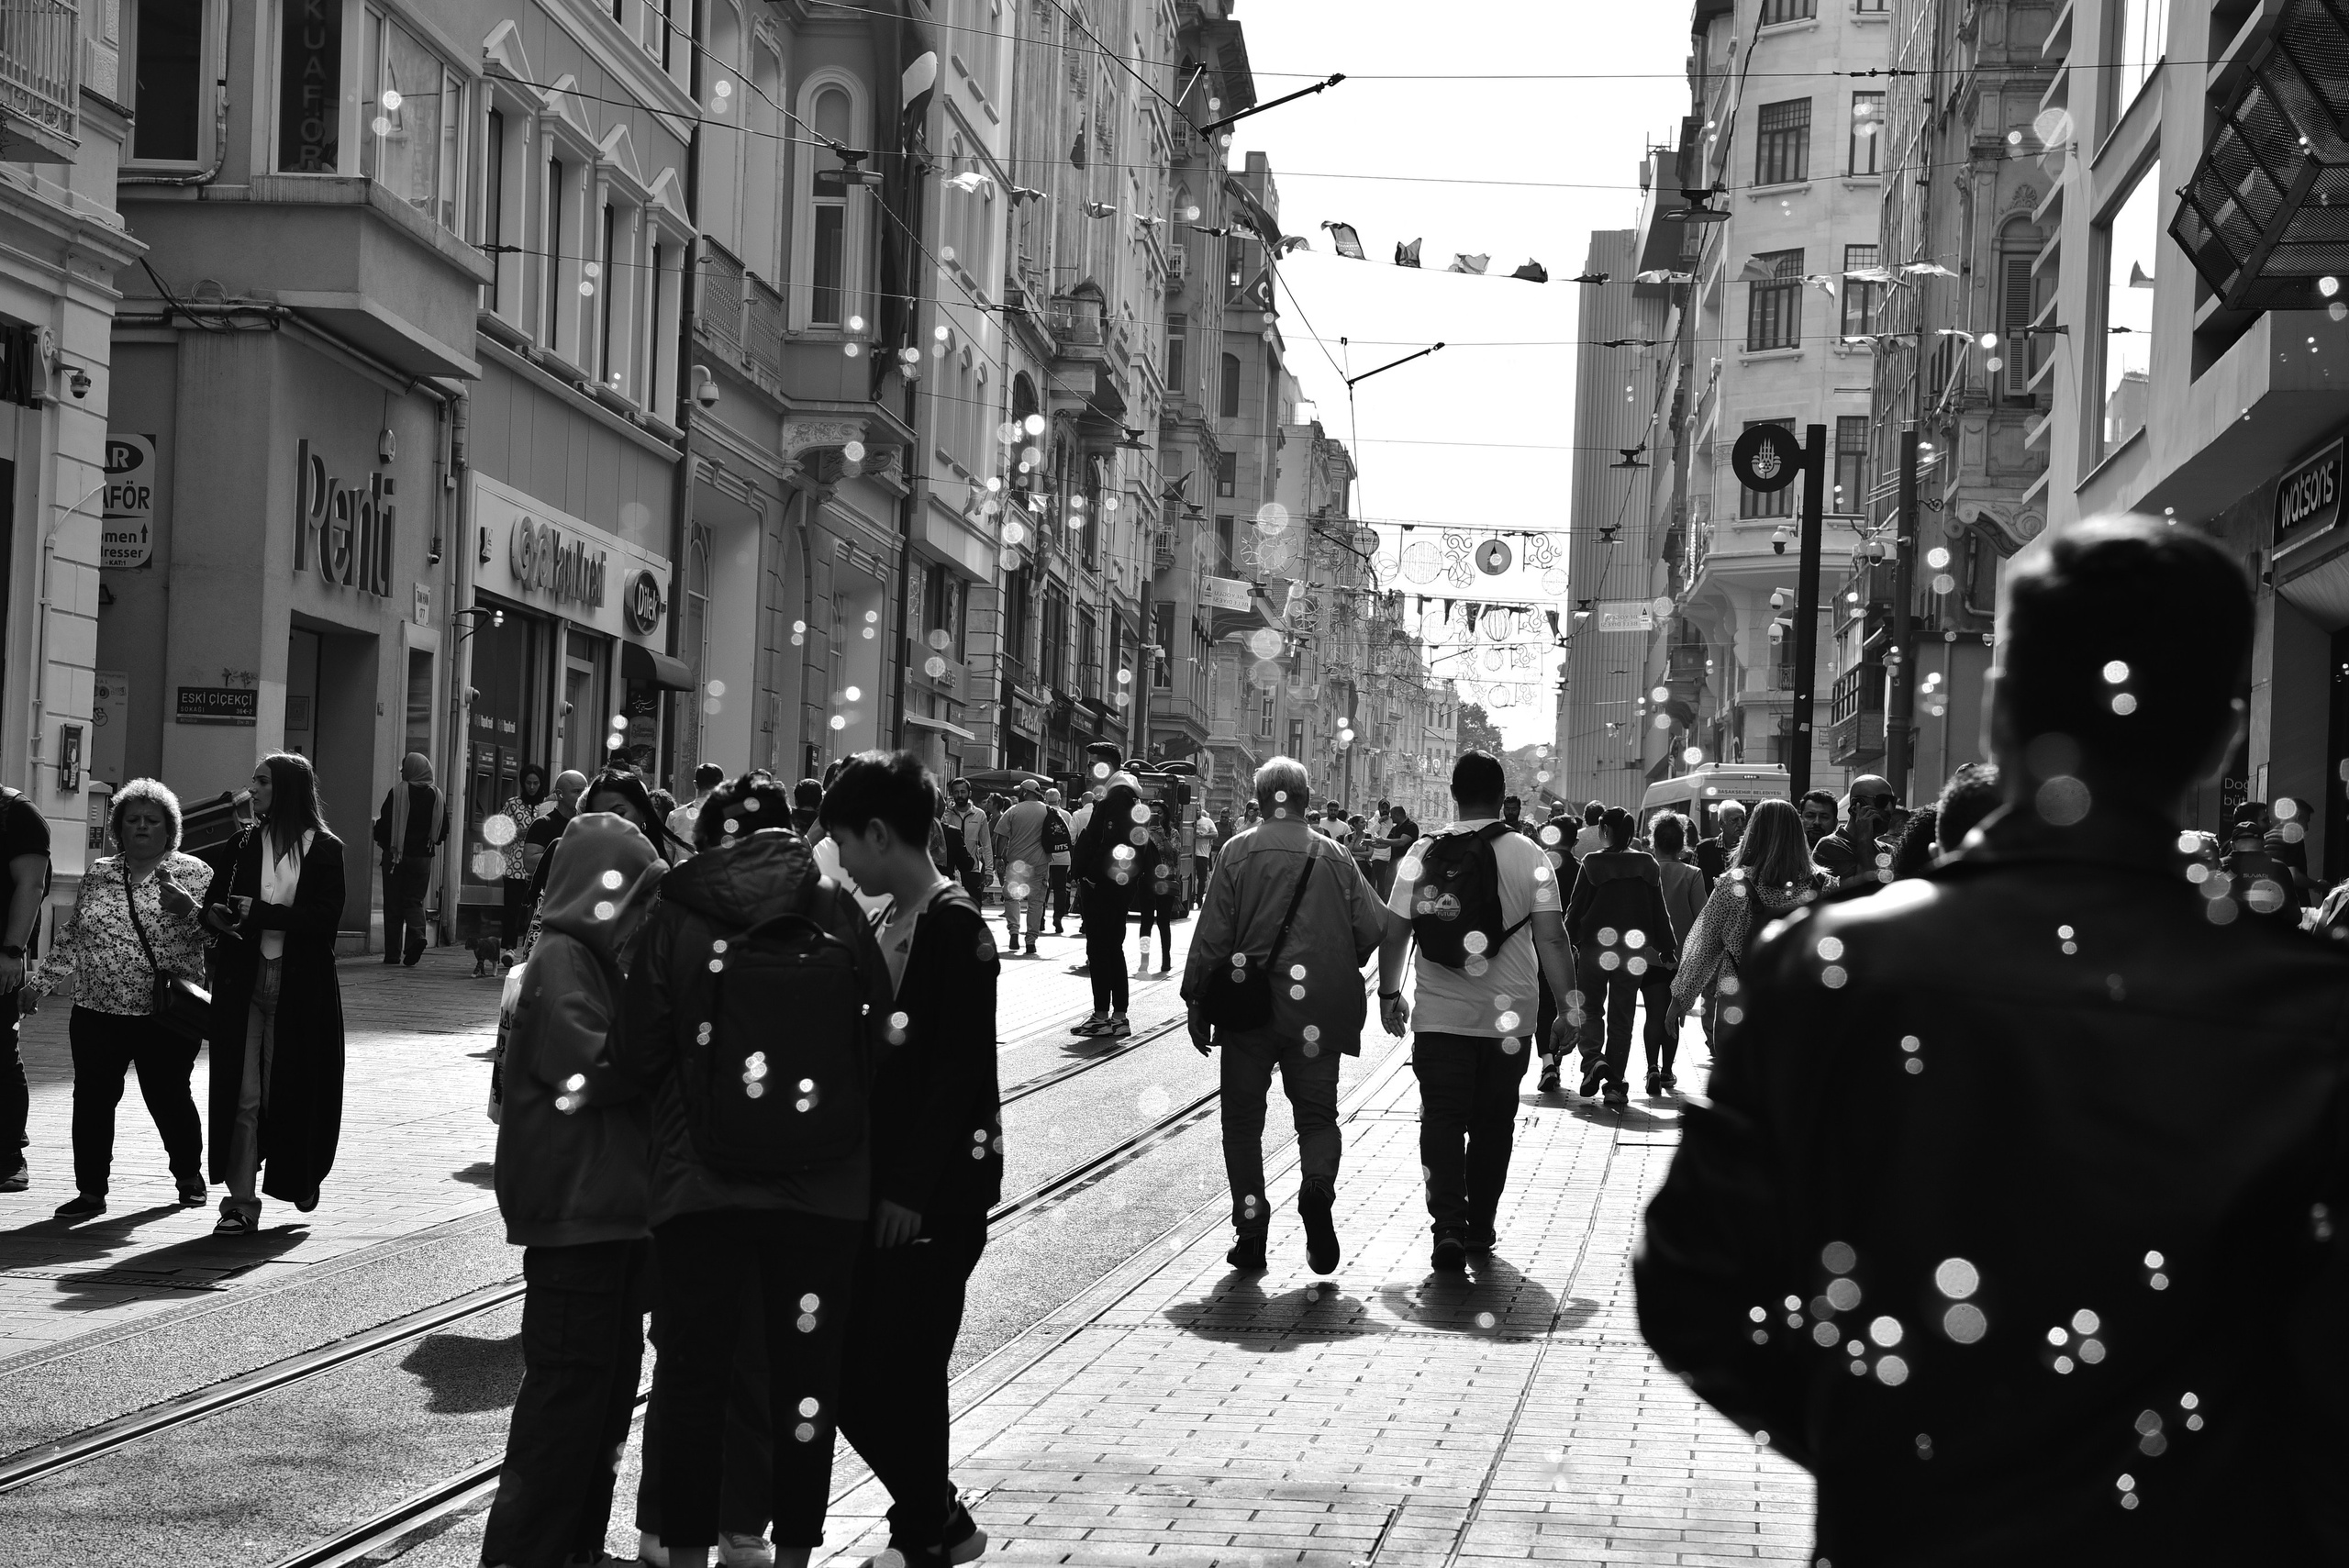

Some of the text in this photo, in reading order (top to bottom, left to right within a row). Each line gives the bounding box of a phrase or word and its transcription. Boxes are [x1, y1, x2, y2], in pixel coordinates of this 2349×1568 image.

[2282, 461, 2333, 528] watsons
[294, 438, 397, 598] Penti
[102, 533, 138, 544] men
[638, 583, 658, 623] Dilek
[182, 692, 252, 706] ESKİ ÇİÇEKÇİ
[1054, 843, 1068, 851] BTS
